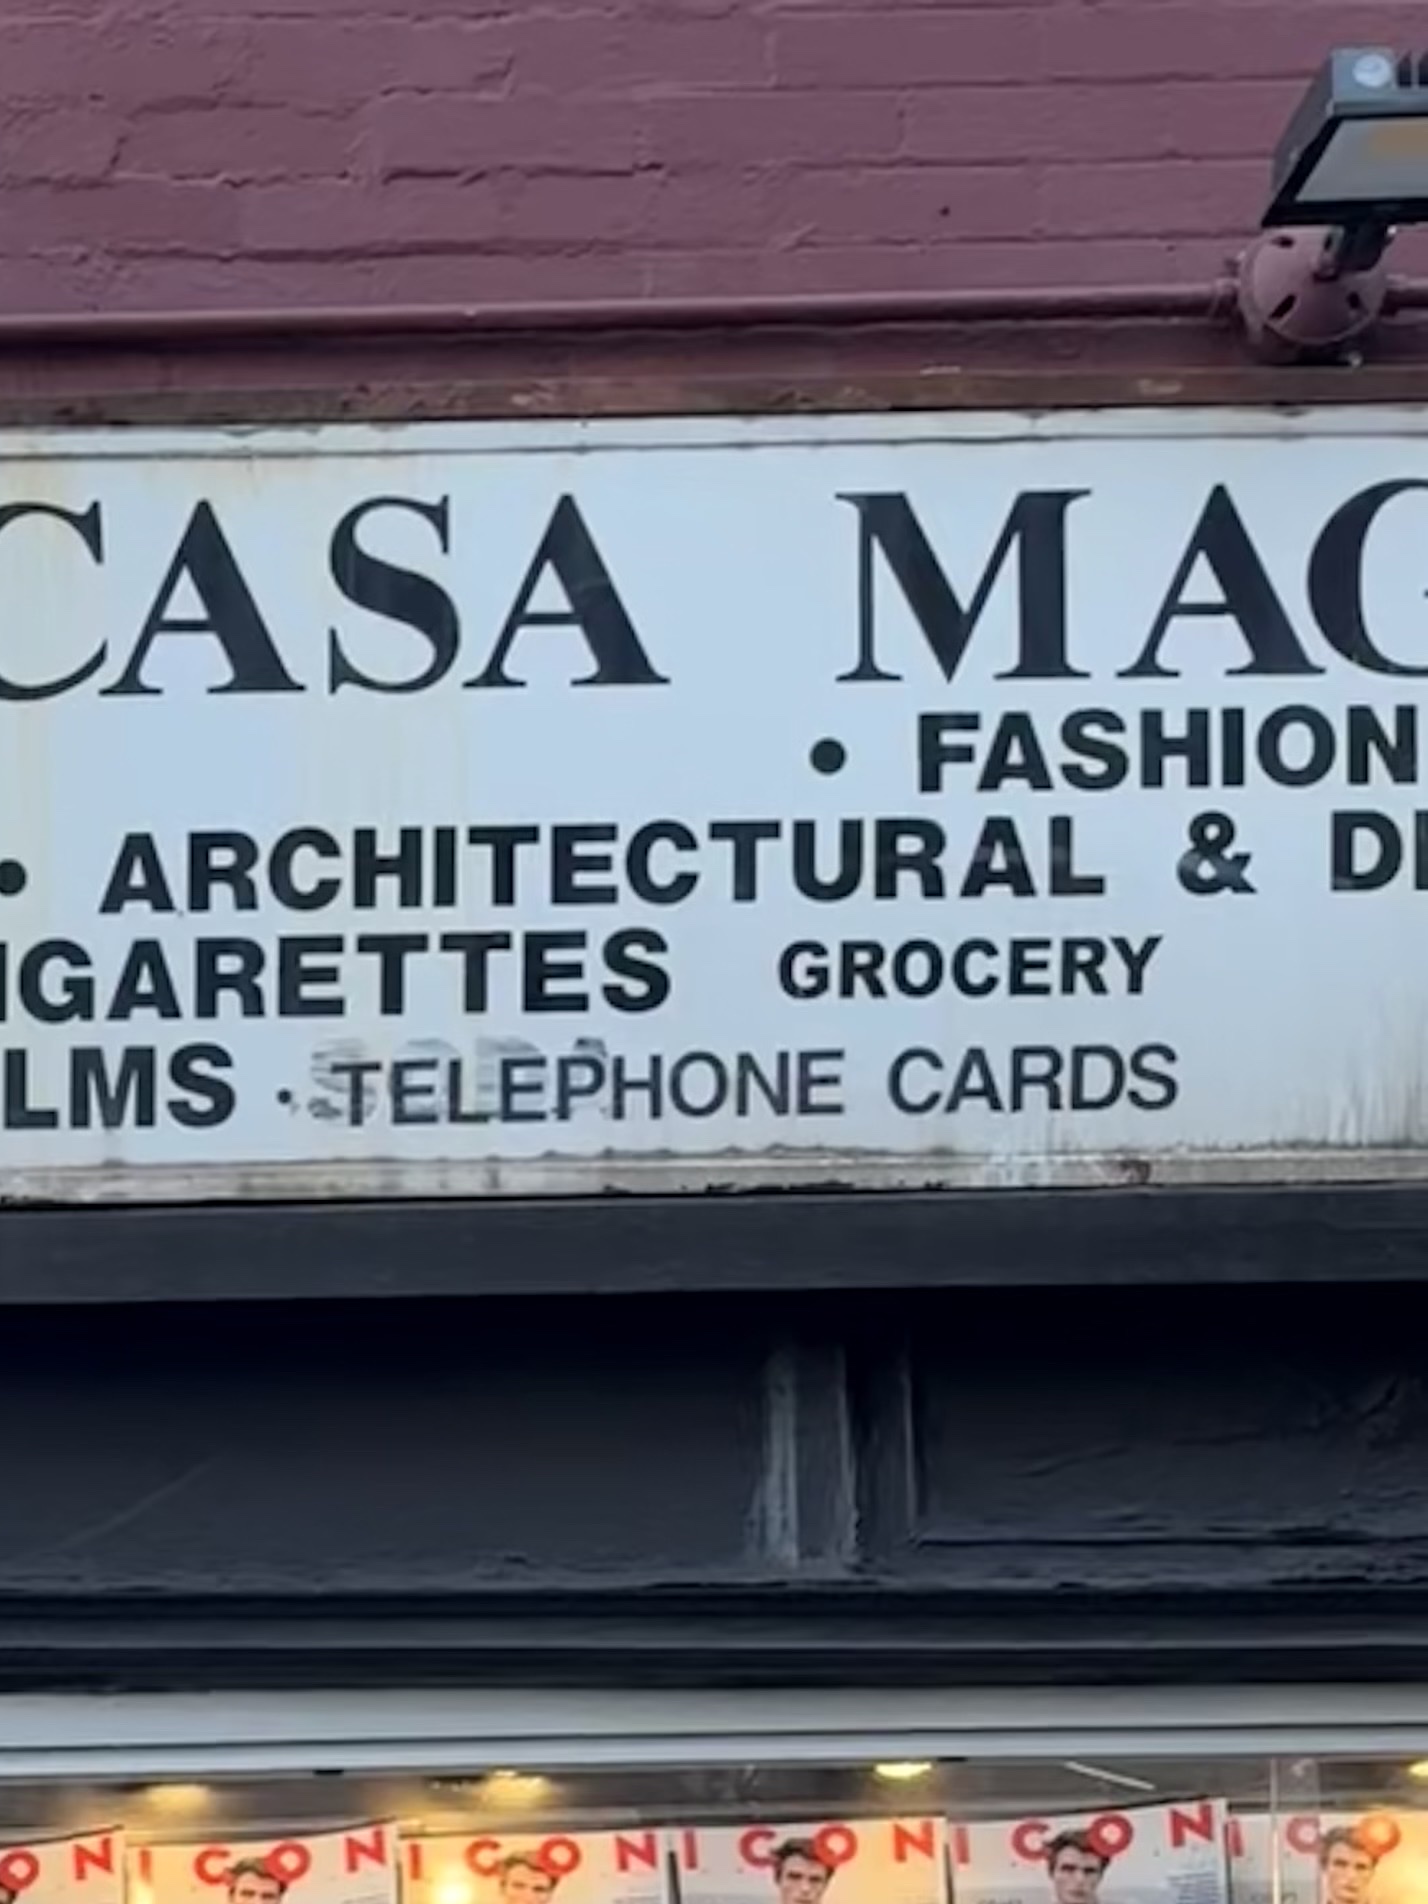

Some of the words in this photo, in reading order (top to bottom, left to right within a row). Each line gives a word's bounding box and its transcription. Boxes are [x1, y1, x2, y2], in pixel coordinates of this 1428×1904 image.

[919, 702, 1419, 795] FASHION
[100, 813, 1105, 916] ARCHITECTURAL
[1176, 822, 1258, 895] &
[777, 934, 1163, 1002] GROCERY
[331, 1047, 846, 1127] TELEPHONE
[889, 1041, 1178, 1114] CARDS
[138, 1828, 387, 1888] ICON
[409, 1831, 658, 1882] ICON
[683, 1822, 936, 1871] ICON
[954, 1803, 1216, 1863] ICON
